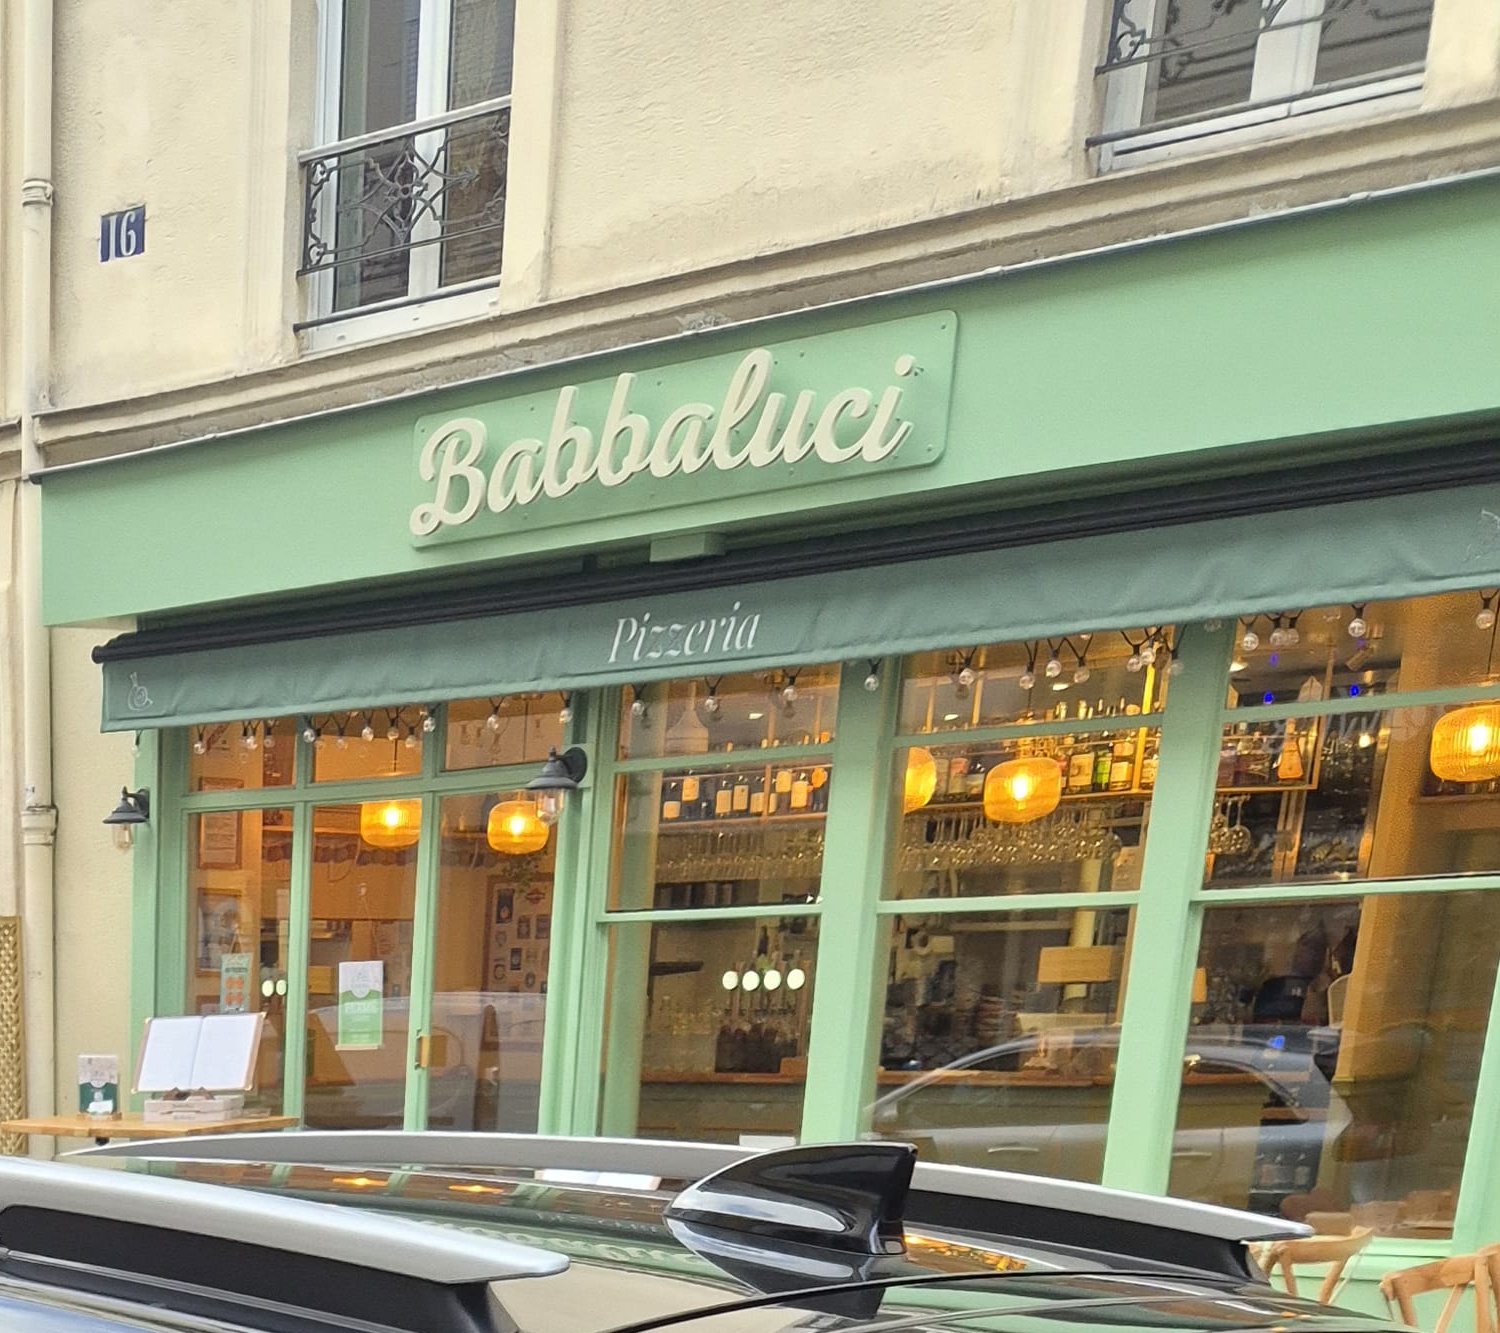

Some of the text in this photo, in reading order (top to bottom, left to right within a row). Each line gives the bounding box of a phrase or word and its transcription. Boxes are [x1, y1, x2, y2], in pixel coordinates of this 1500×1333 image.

[108, 211, 137, 261] 16
[409, 348, 914, 537] Babbaluci
[607, 600, 762, 664] Pizzeria
